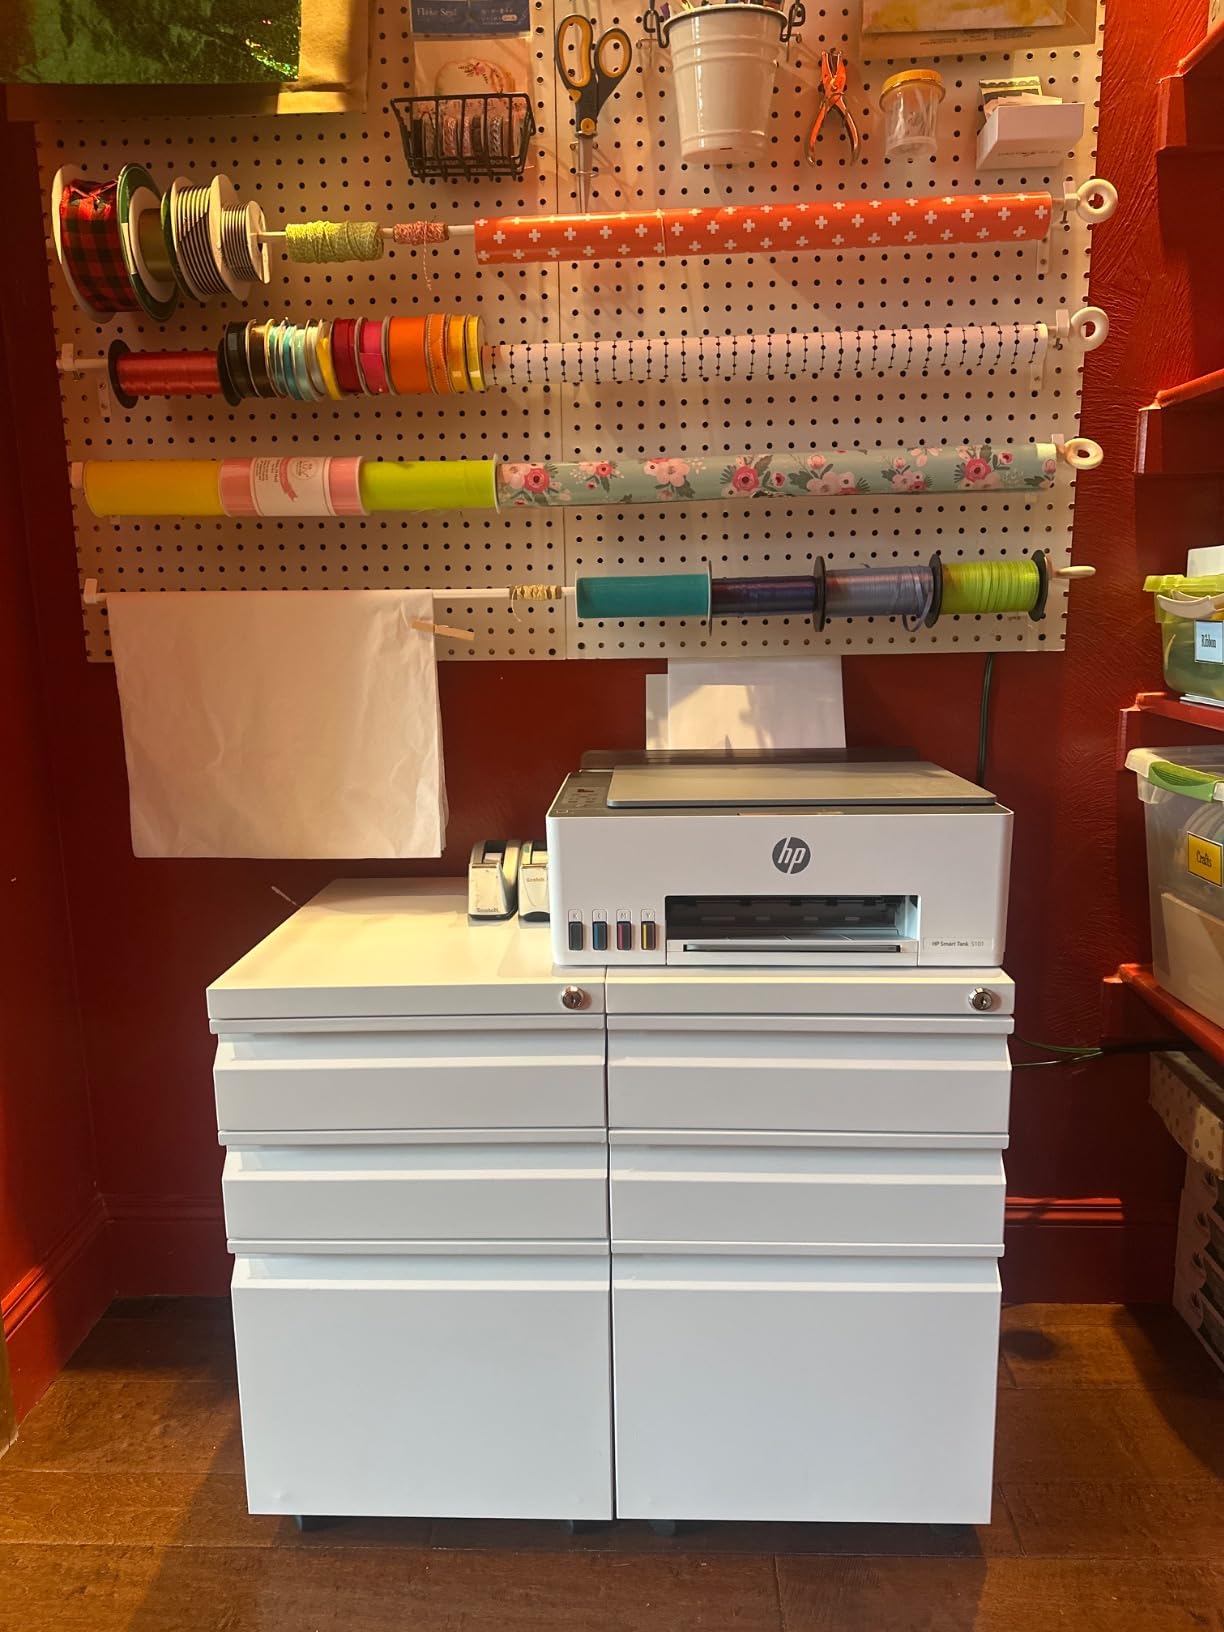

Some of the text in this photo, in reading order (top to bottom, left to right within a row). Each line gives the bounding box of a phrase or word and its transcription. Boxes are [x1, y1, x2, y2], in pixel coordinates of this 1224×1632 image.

[1201, 633, 1217, 648] Ribbon
[776, 836, 807, 874] hp
[1196, 850, 1212, 867] Crafts
